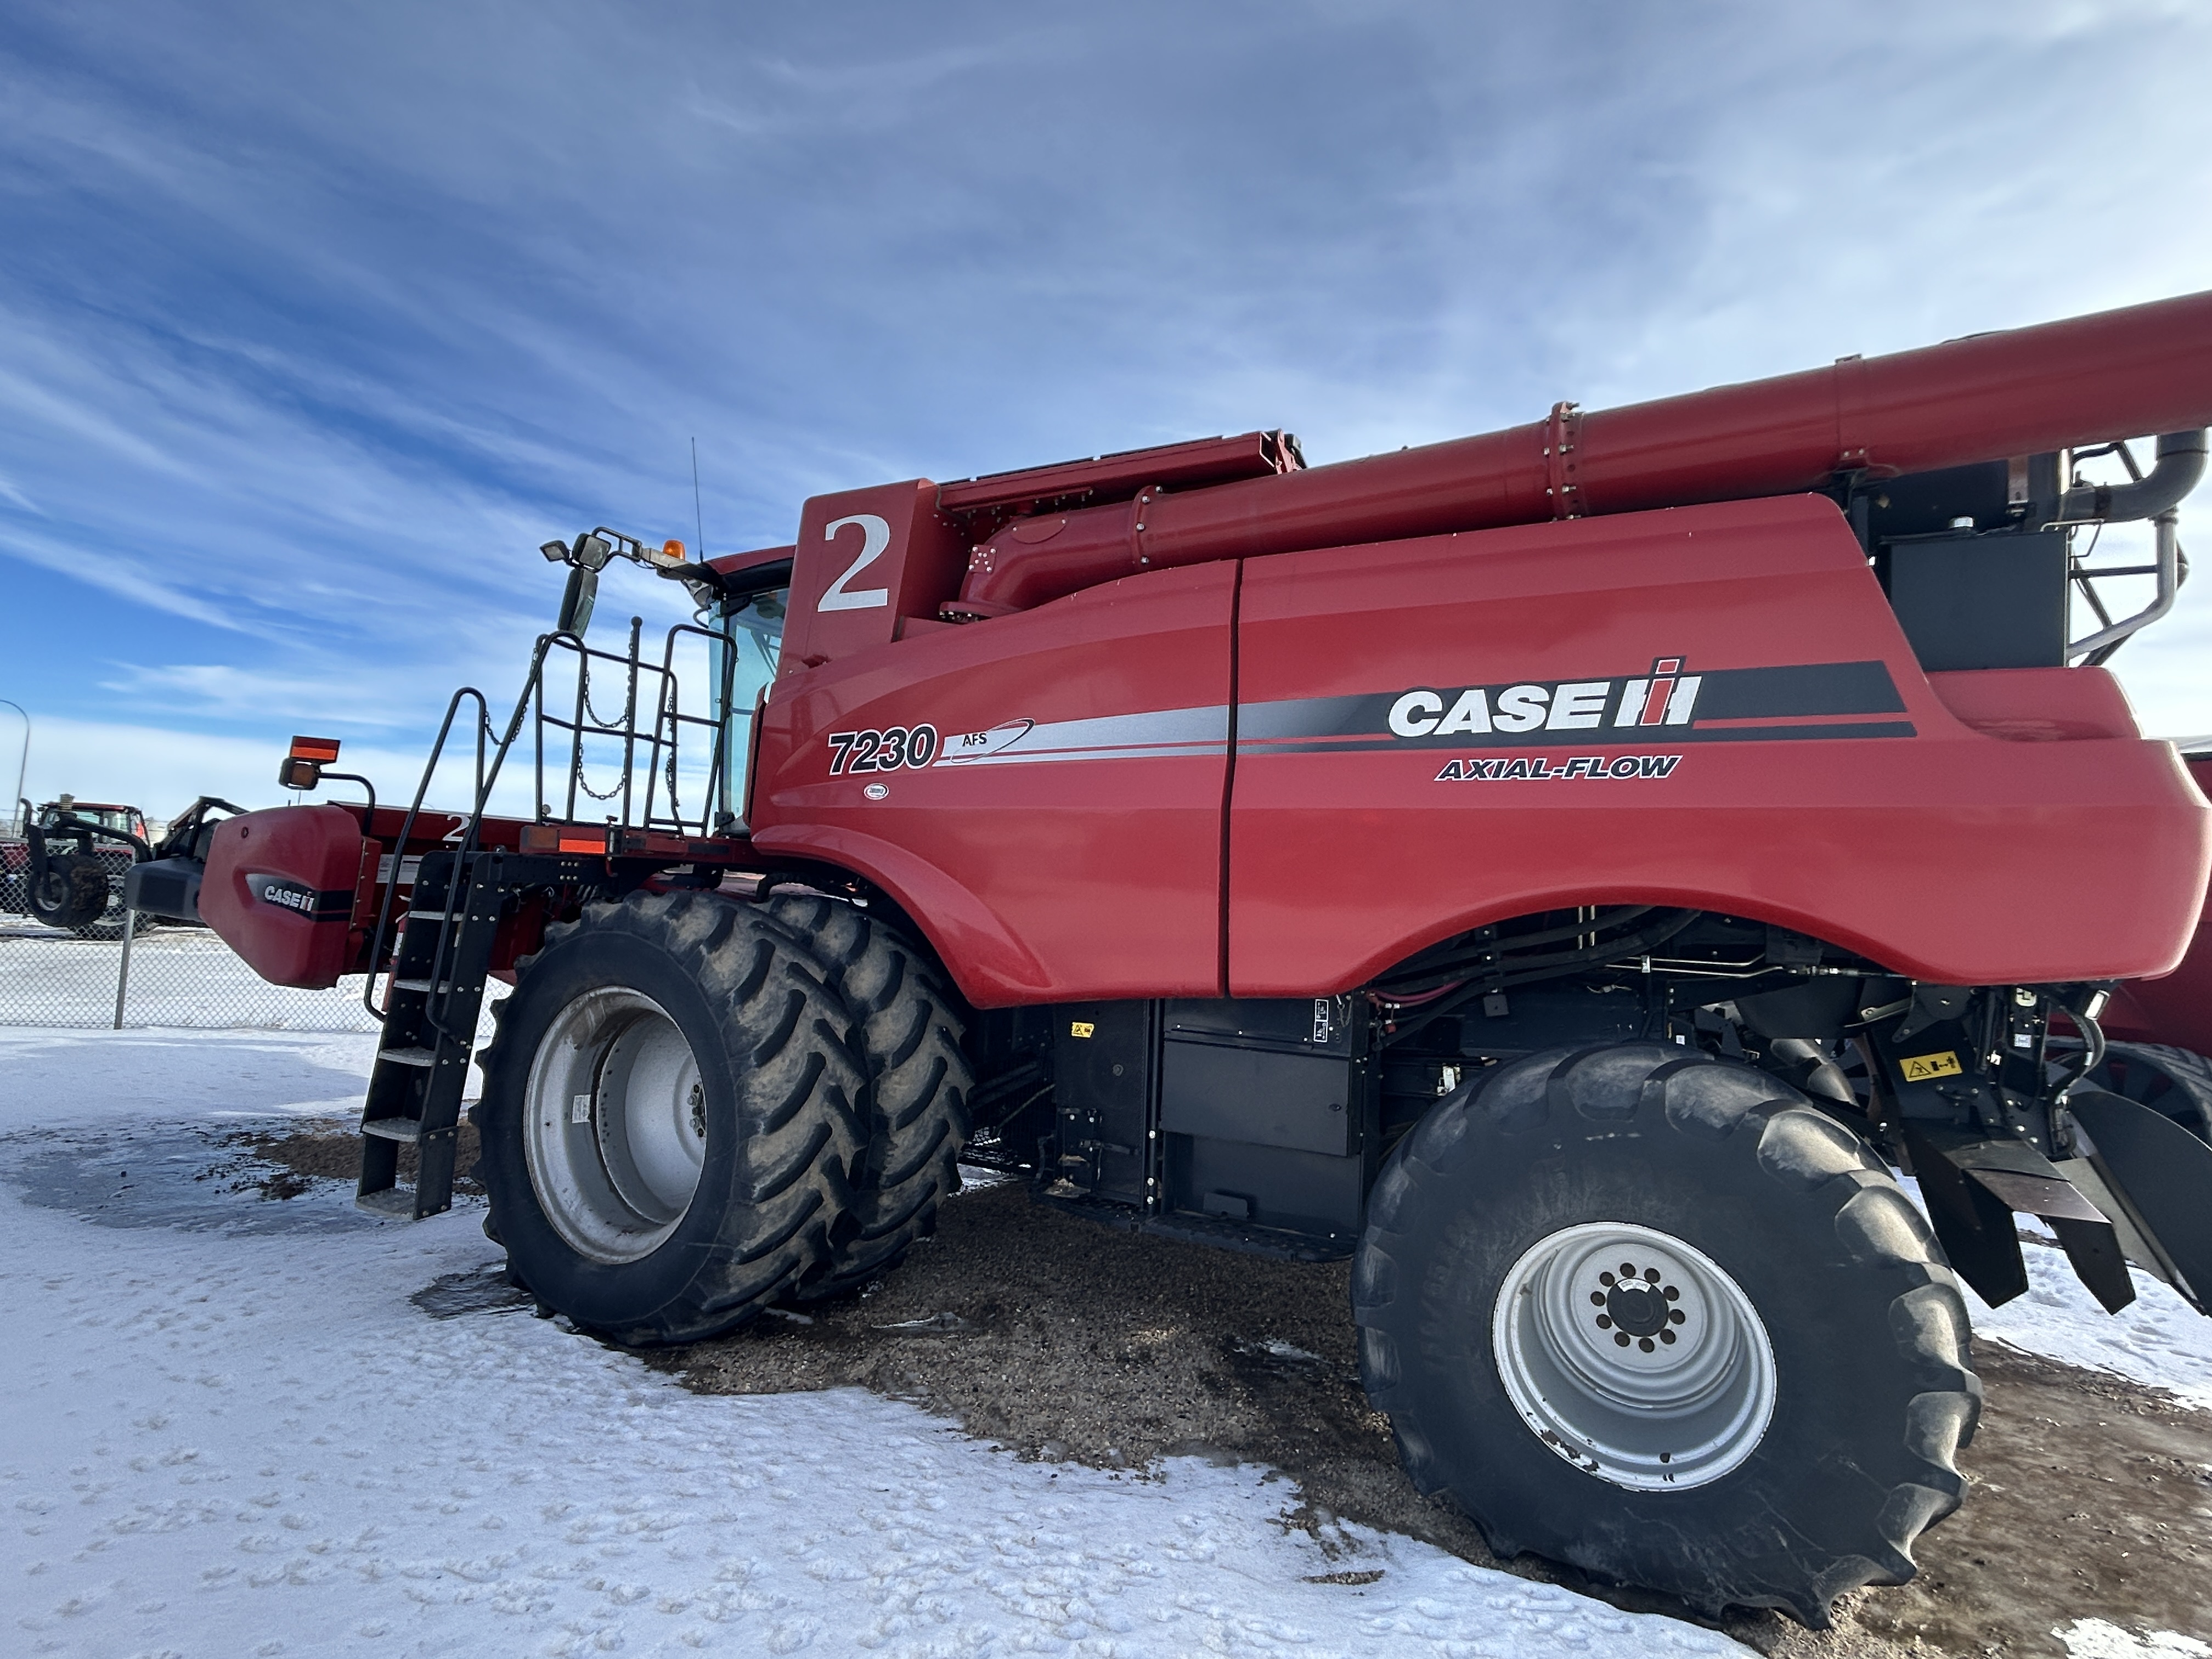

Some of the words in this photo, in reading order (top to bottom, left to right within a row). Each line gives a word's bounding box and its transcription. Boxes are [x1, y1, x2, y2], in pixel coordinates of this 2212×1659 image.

[817, 514, 891, 612] 2
[1388, 681, 1611, 737] CASE
[828, 723, 938, 775] 7230
[962, 732, 988, 747] AFS
[1434, 755, 1682, 781] AXIAL-FLOW
[442, 814, 471, 842] 2
[264, 885, 302, 907] CASE
